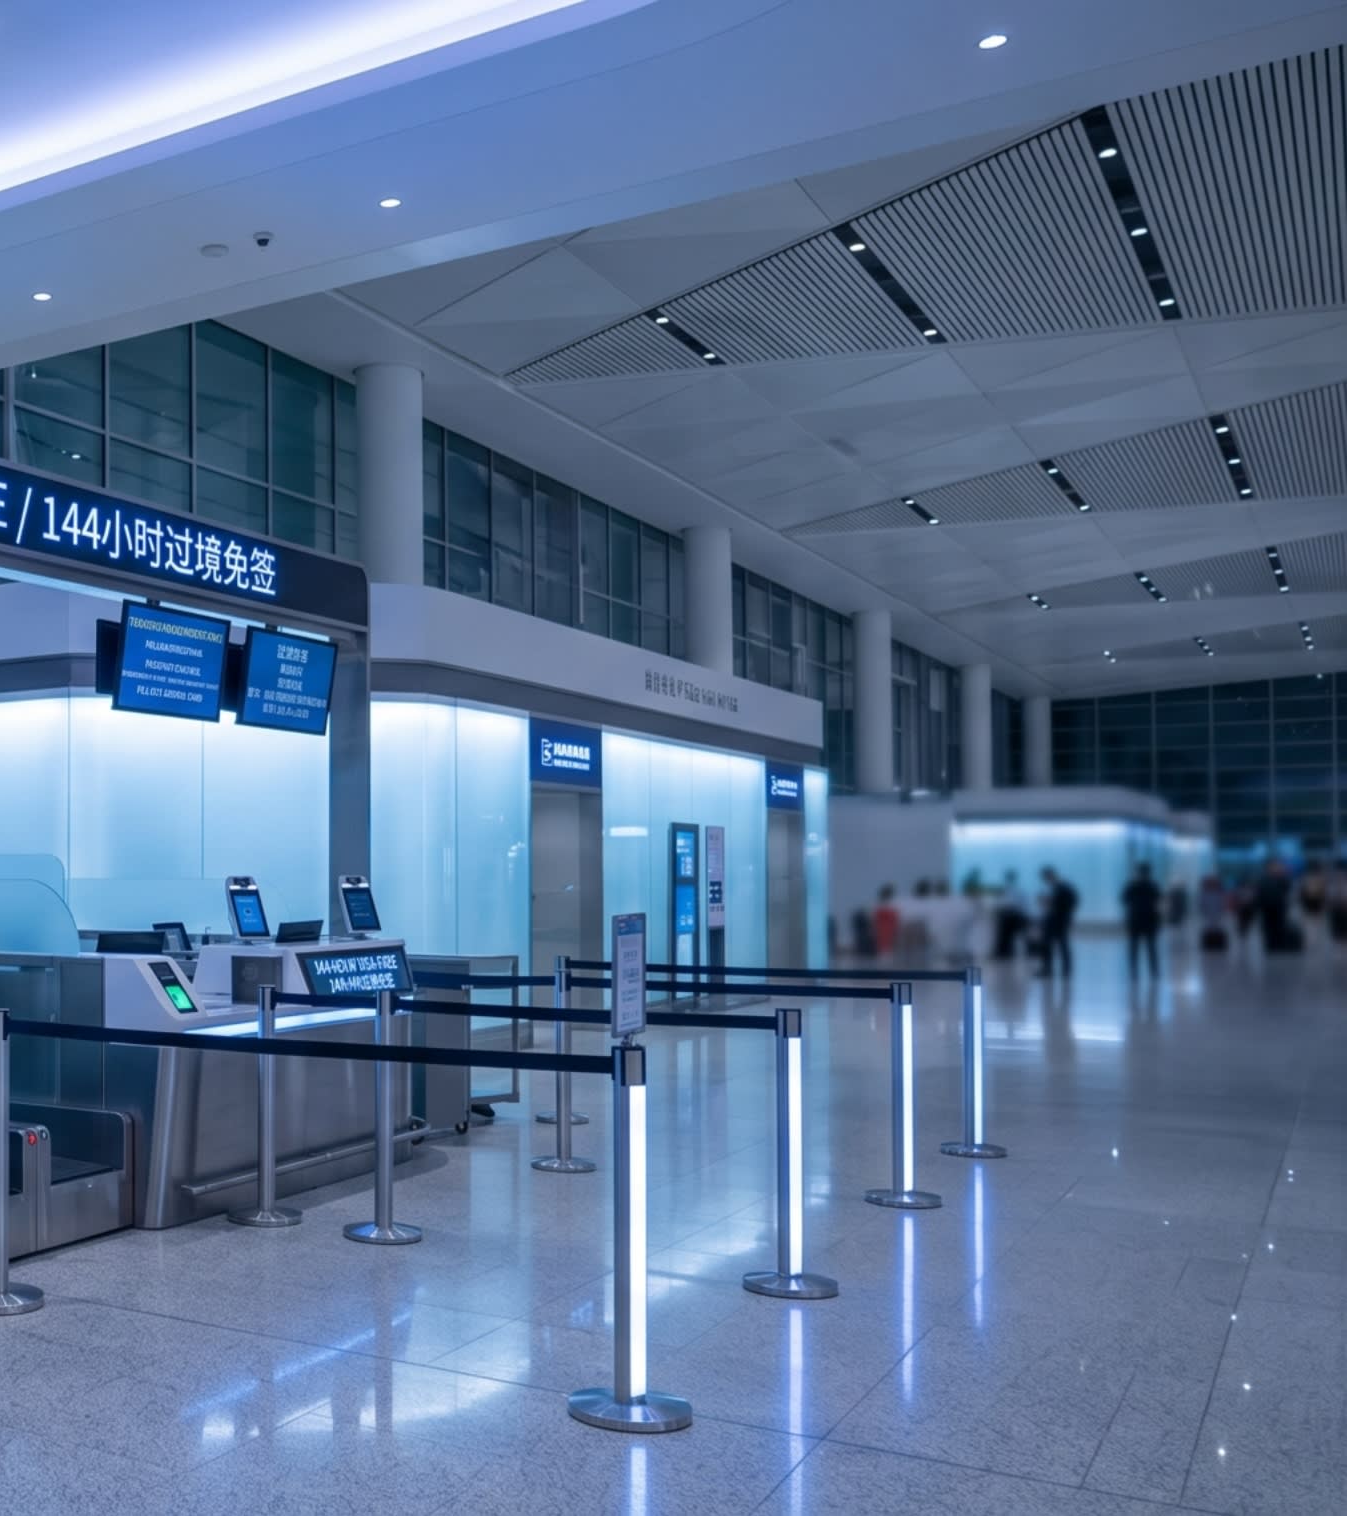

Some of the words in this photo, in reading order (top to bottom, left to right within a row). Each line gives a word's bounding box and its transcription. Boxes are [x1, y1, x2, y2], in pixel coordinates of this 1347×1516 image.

[16, 488, 32, 544] /
[43, 497, 276, 595] 144小时过境免签
